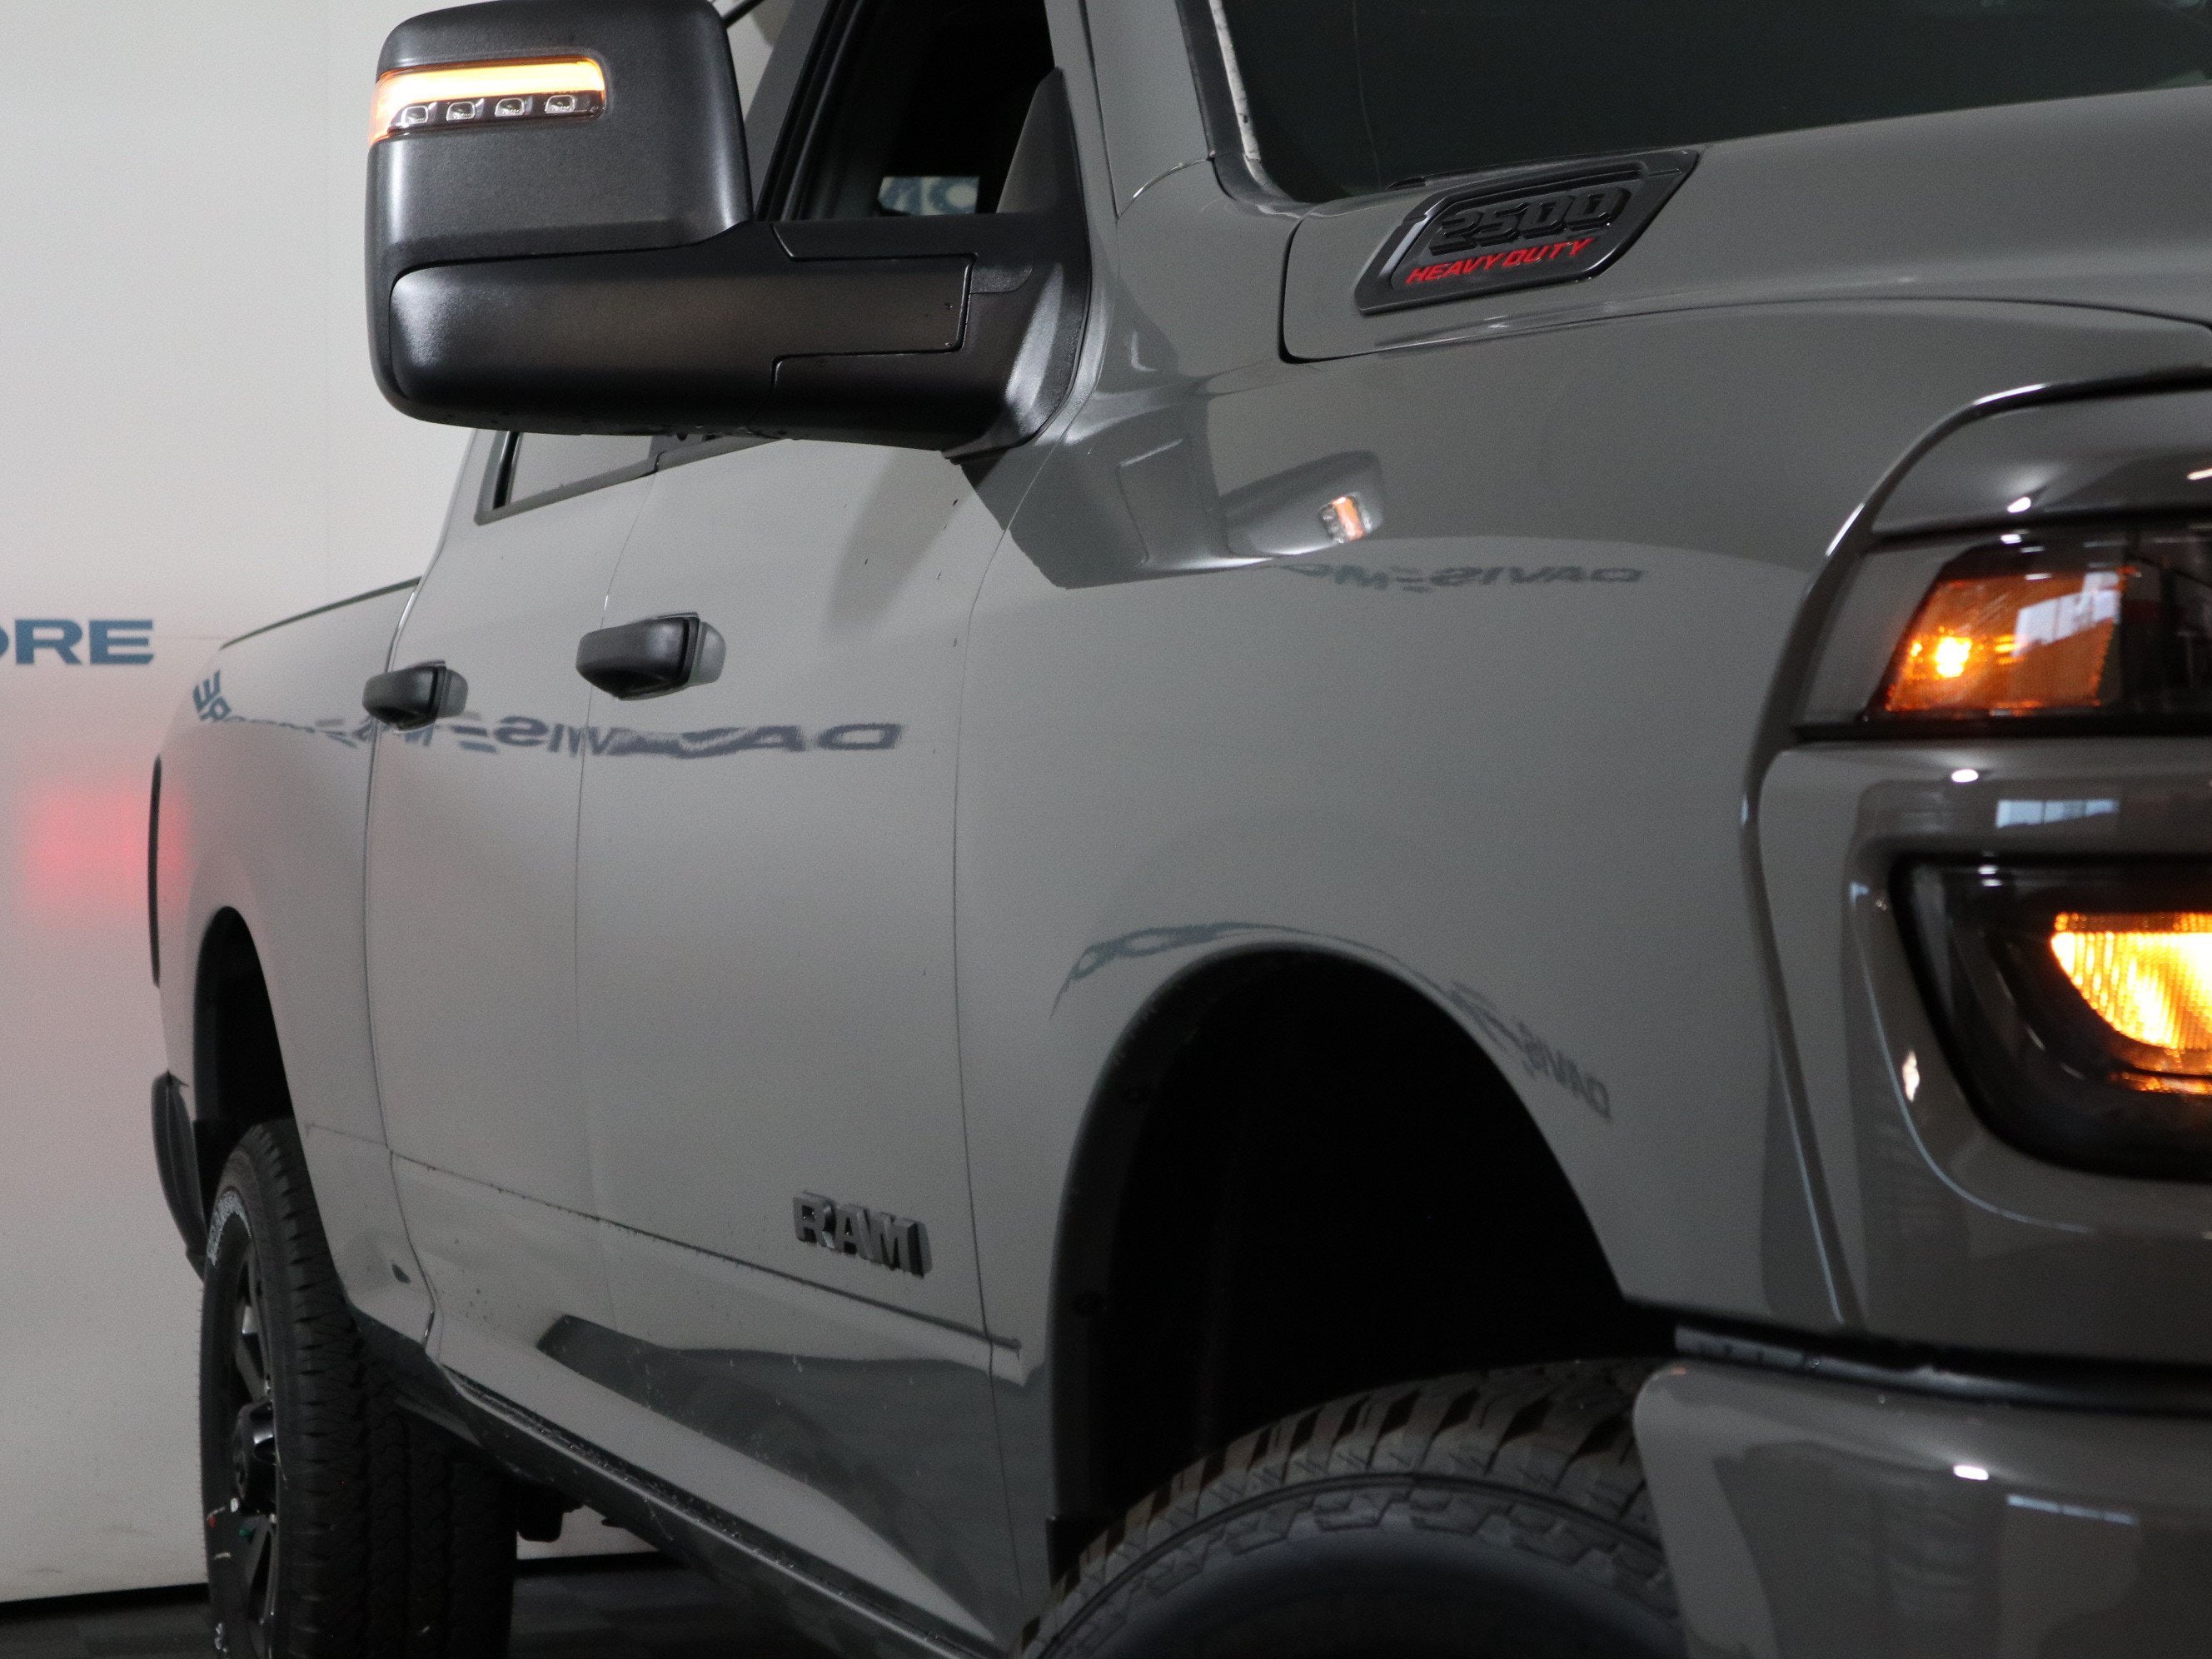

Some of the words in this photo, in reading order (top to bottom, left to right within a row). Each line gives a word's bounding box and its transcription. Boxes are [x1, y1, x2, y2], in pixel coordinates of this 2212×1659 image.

[1428, 187, 1632, 257] 2500
[1405, 252, 1504, 285] HEAVY
[1502, 237, 1596, 267] DUTY
[0, 619, 154, 665] RE
[793, 1191, 933, 1278] RAM
